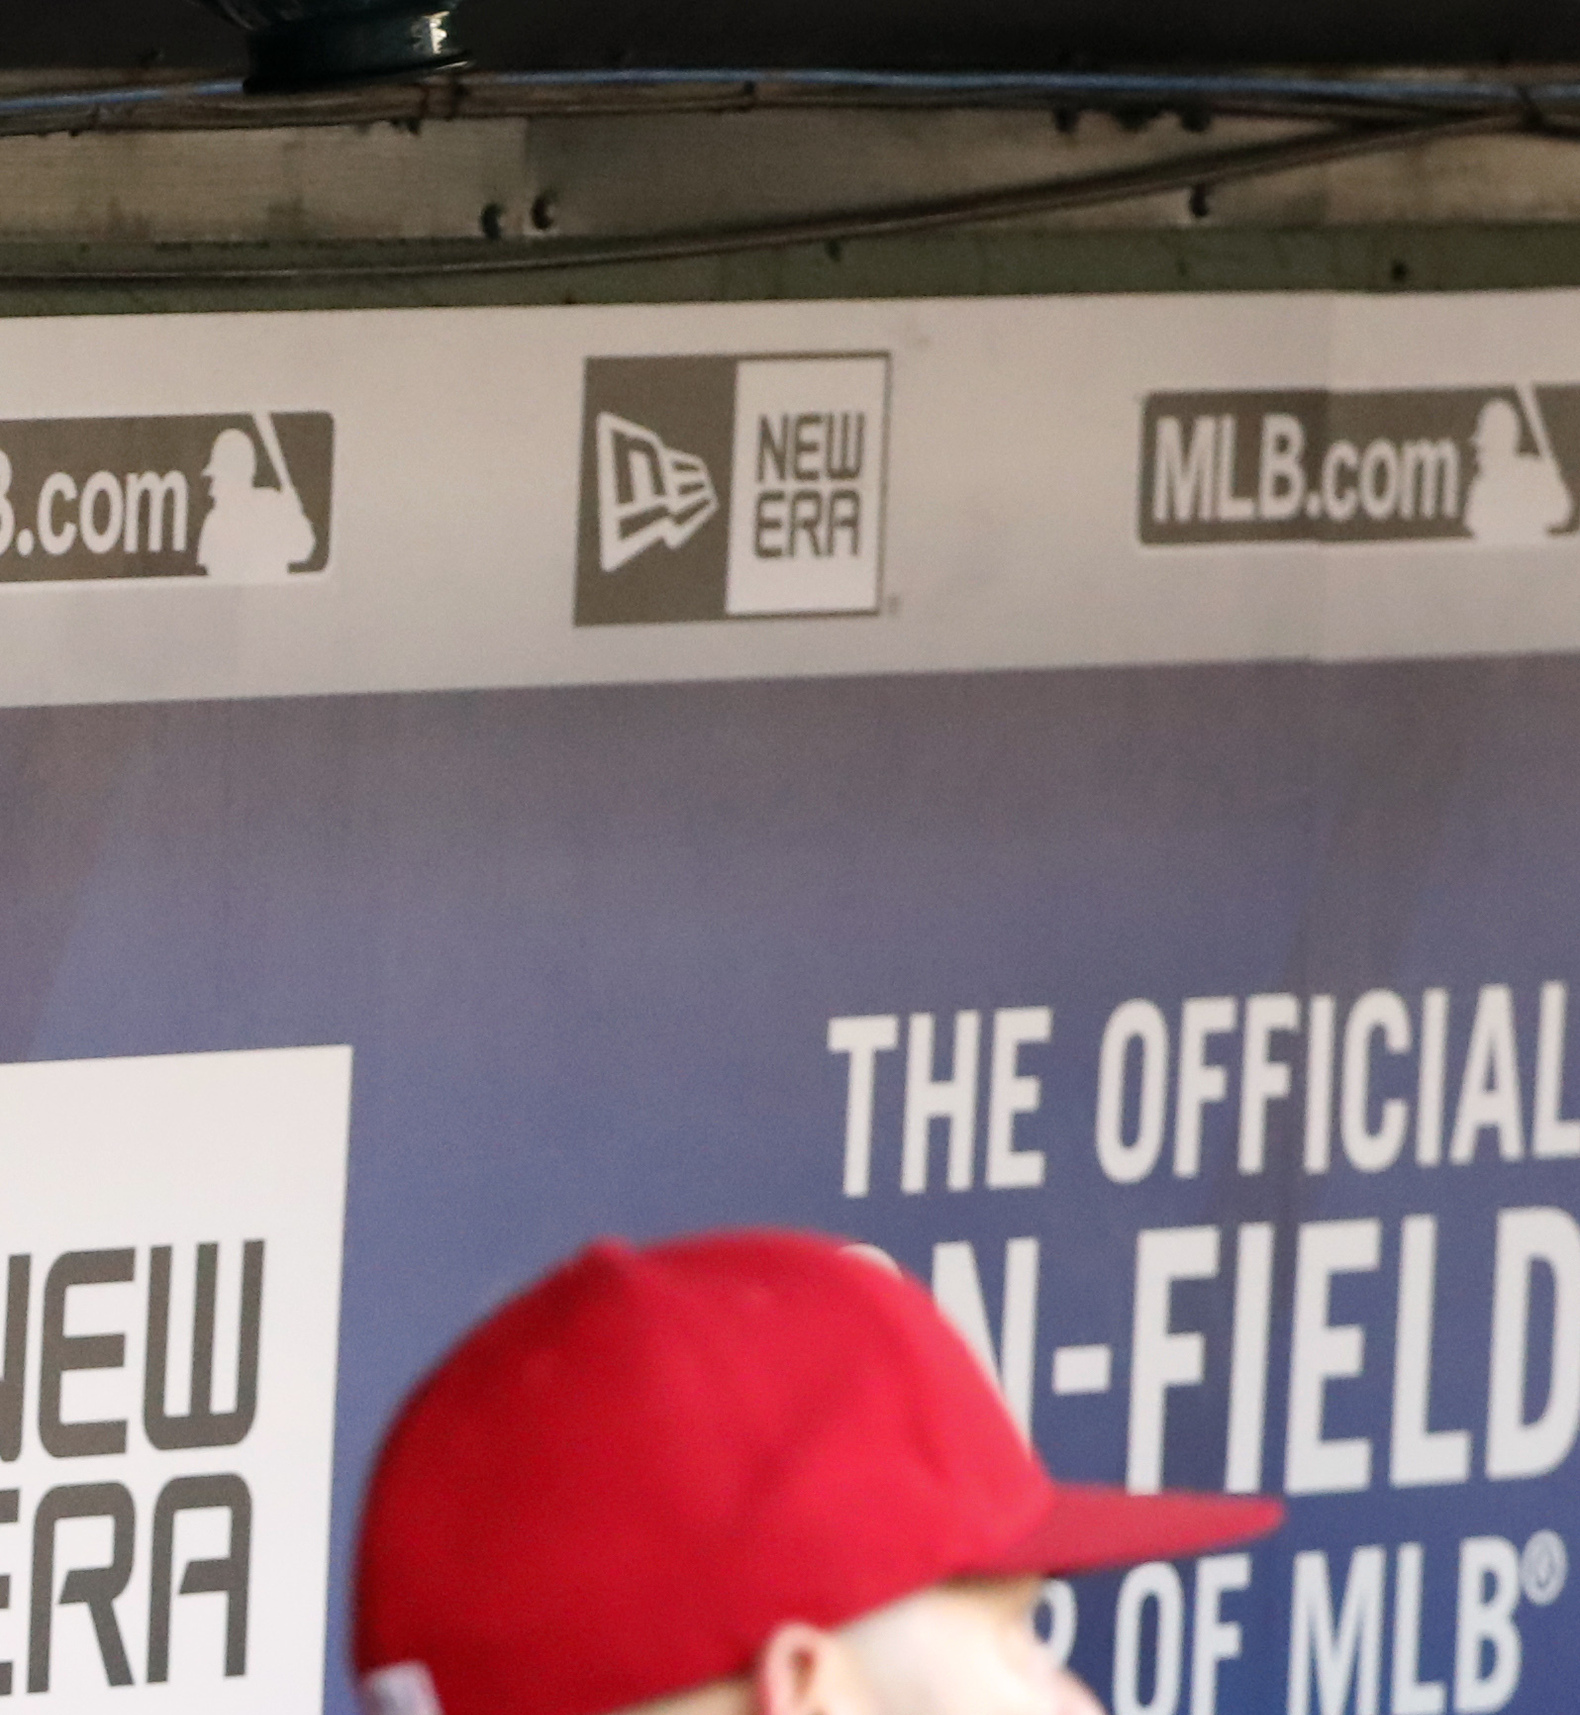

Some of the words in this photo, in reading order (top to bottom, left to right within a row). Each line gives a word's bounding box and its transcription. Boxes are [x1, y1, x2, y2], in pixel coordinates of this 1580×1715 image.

[756, 411, 866, 484] NEW
[1152, 411, 1461, 523] MLB.com
[753, 488, 861, 559] ERA
[827, 1006, 1053, 1198] THE
[1095, 979, 1580, 1184] OFFICIAL
[840, 1206, 1580, 1498] N-FIELD
